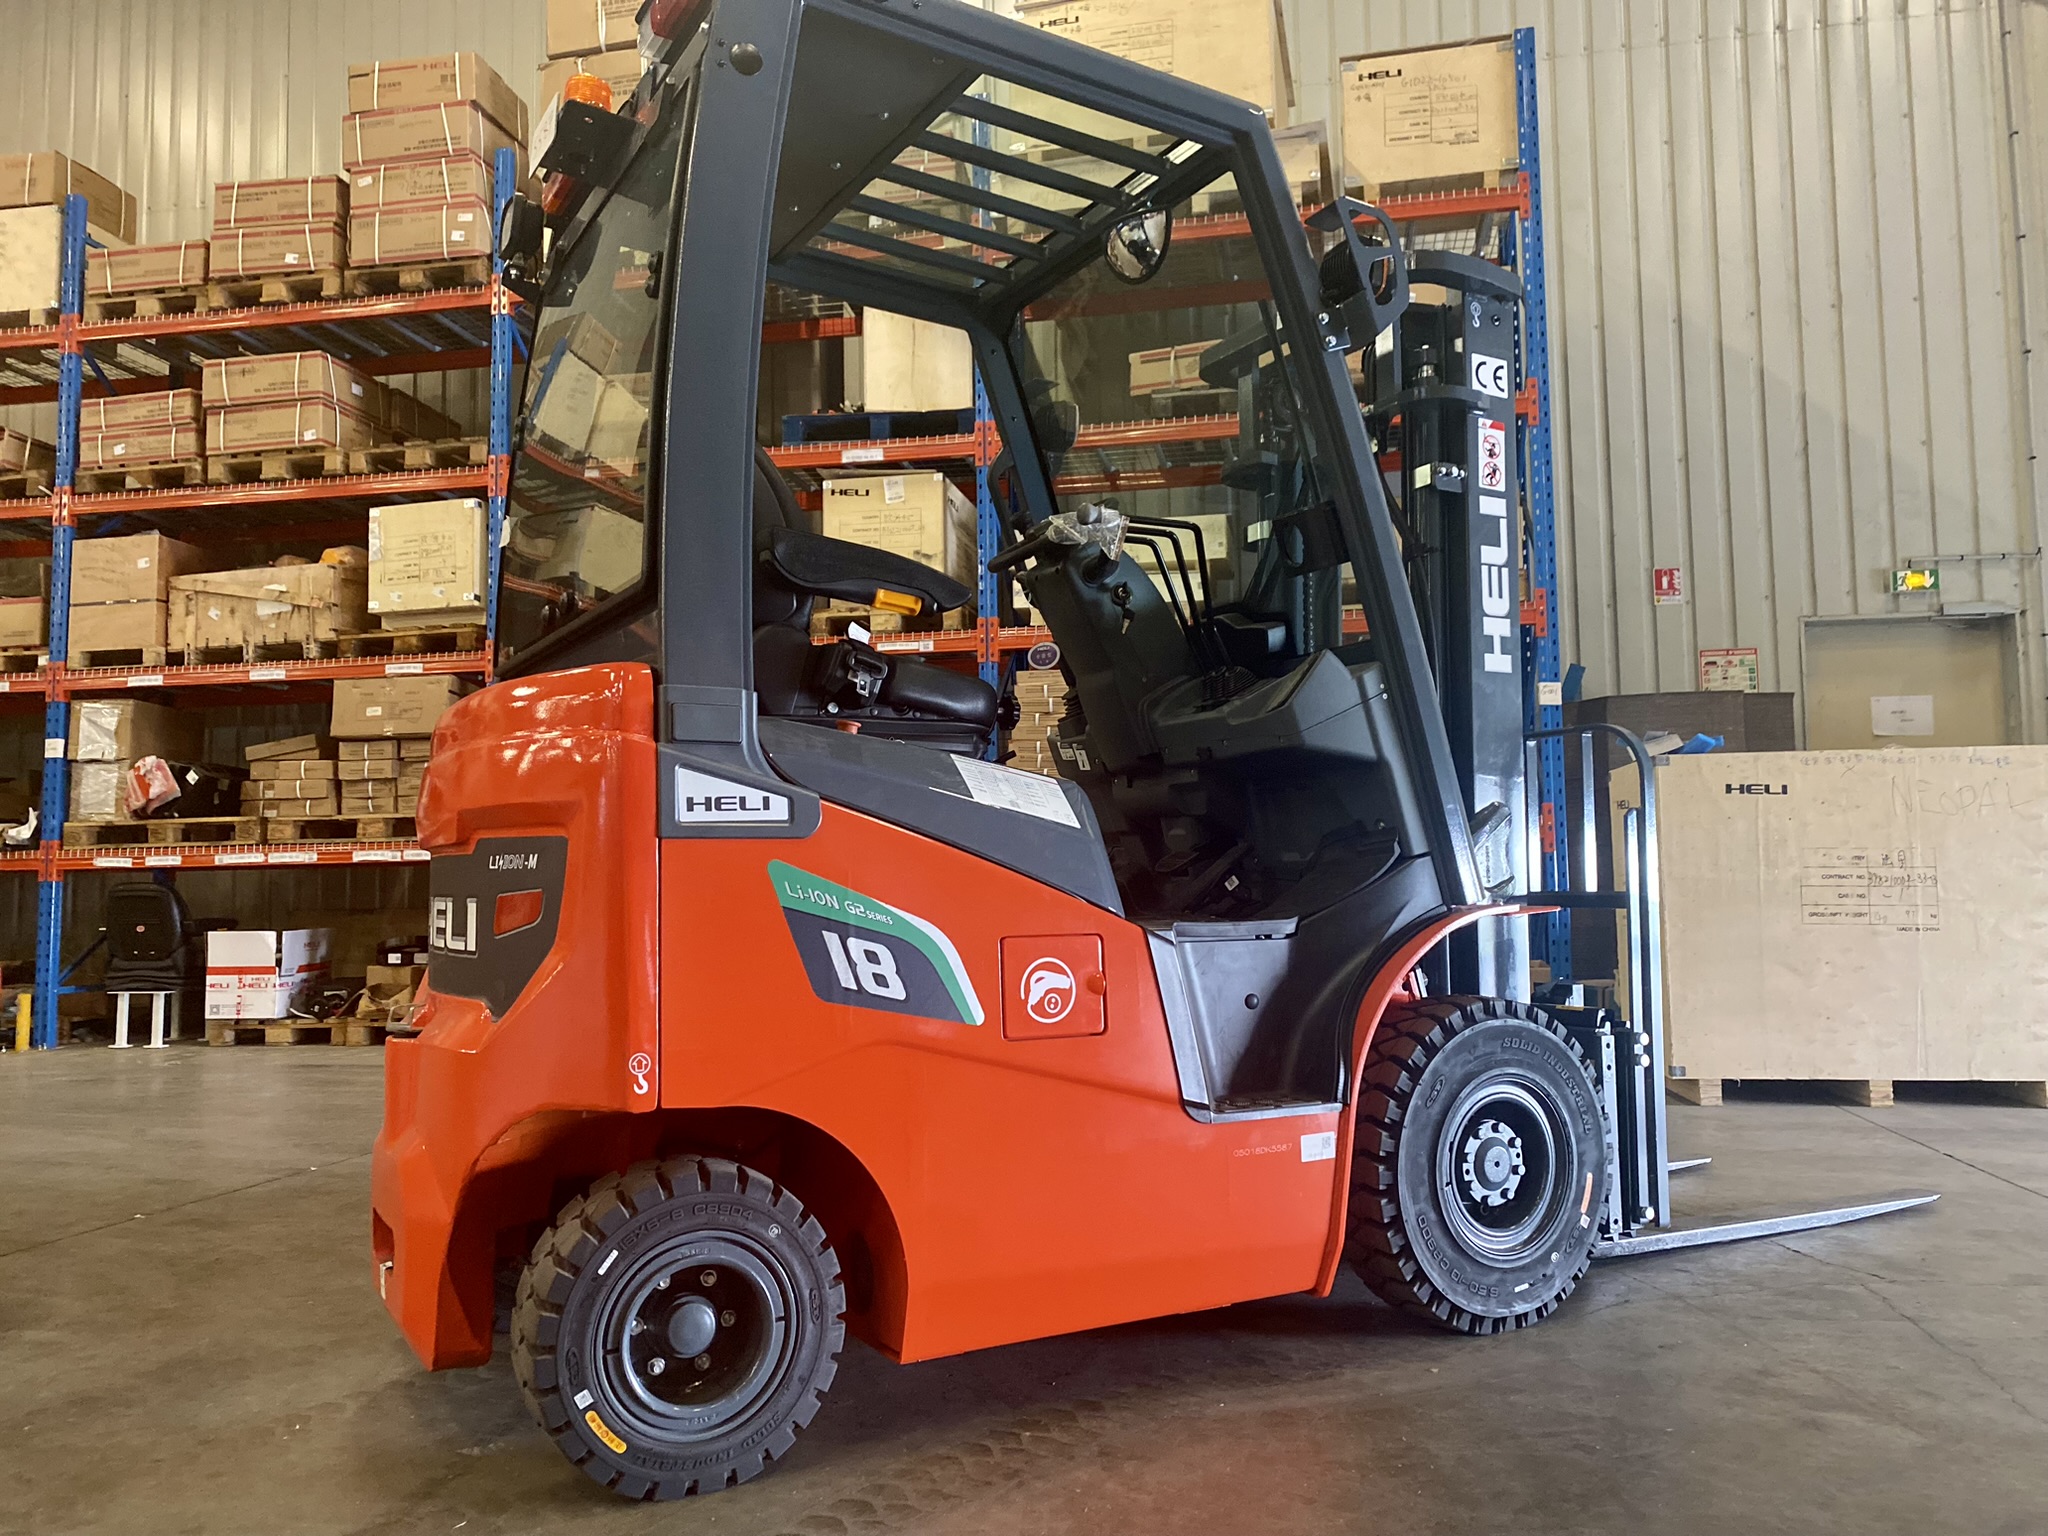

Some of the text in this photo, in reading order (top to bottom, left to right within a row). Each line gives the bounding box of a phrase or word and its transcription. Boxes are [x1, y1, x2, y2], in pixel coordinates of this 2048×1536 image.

[1039, 15, 1079, 28] HELI
[1358, 69, 1402, 82] HELI
[1475, 361, 1505, 393] CE
[830, 489, 870, 497] HELI
[1479, 495, 1513, 674] HELI
[1724, 783, 1788, 796] HELI
[686, 795, 770, 813] HELI
[429, 897, 478, 957] ELI
[866, 911, 894, 926] SERIES
[821, 929, 908, 1001] 18
[1502, 1037, 1593, 1135] SOLID INDUSTRIAL
